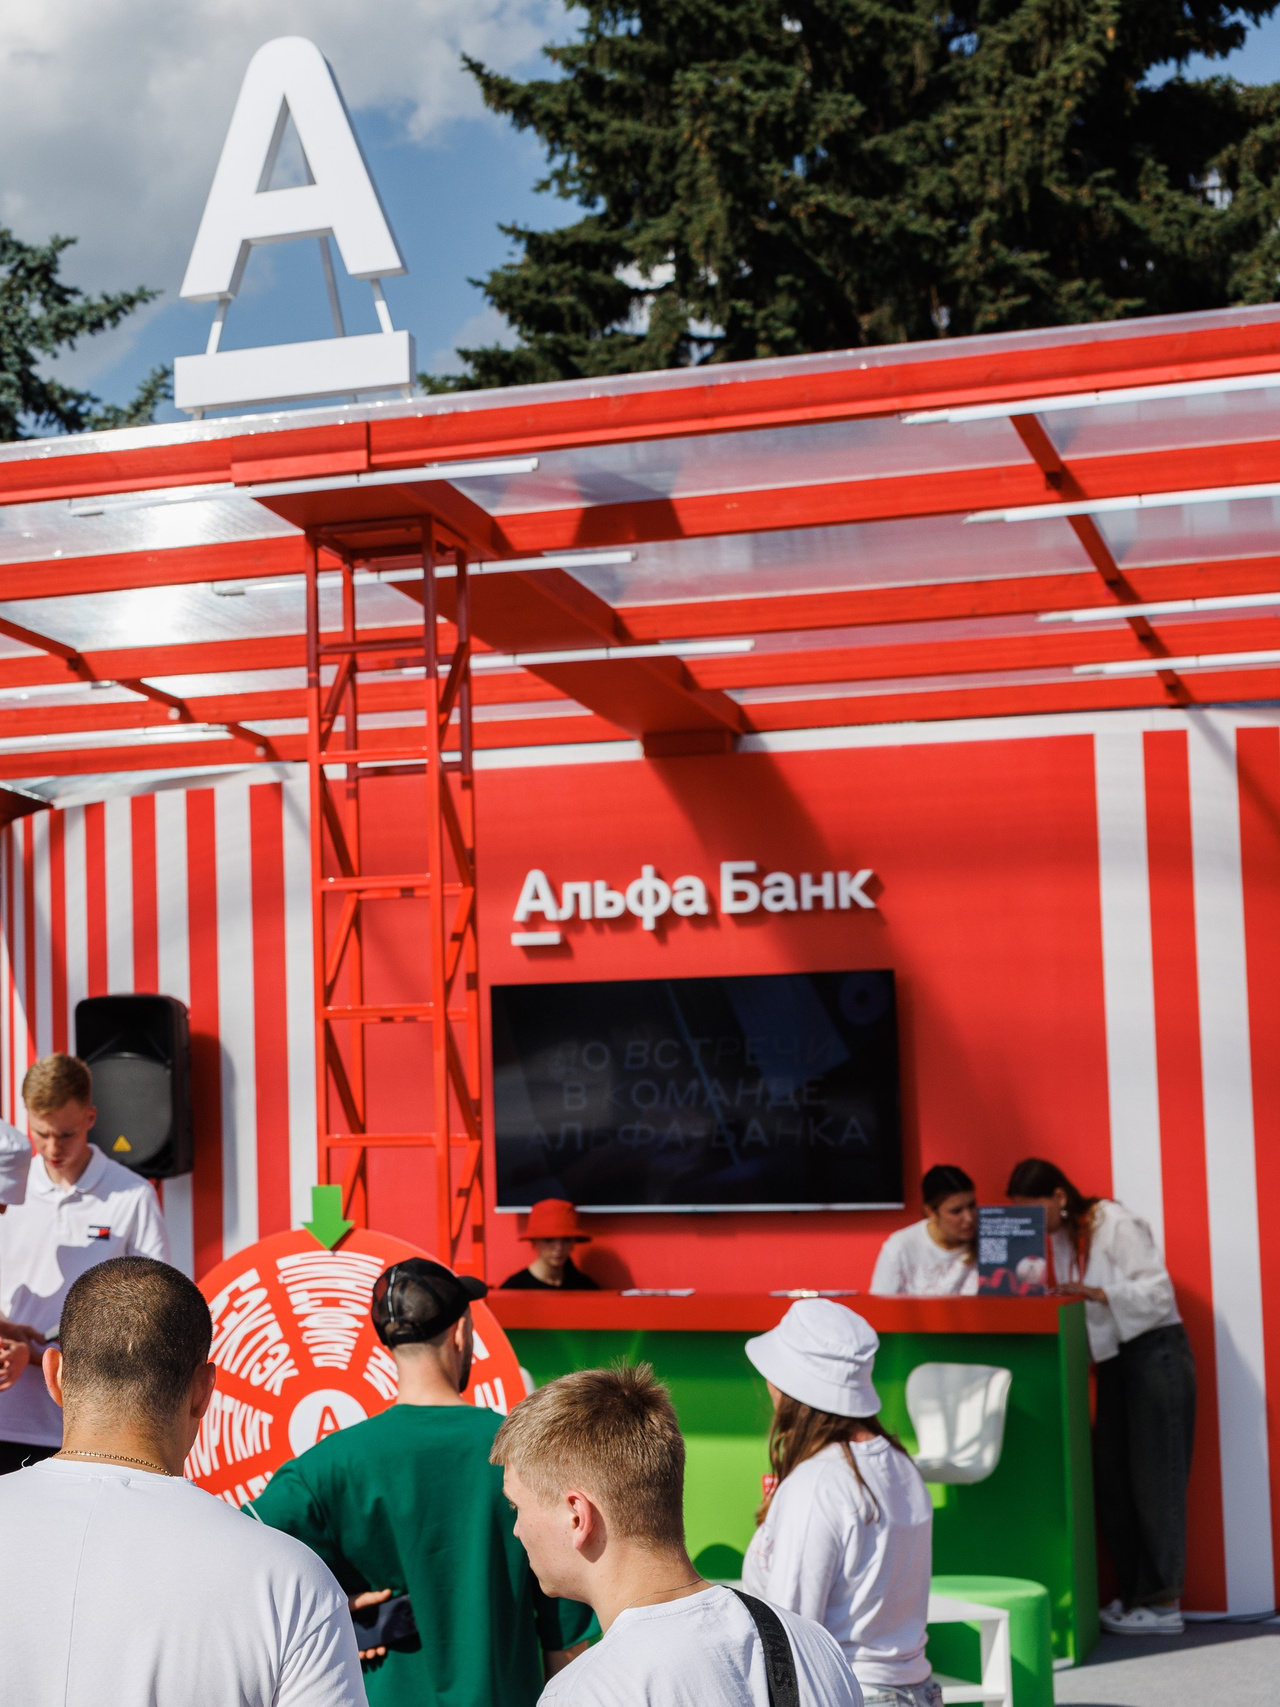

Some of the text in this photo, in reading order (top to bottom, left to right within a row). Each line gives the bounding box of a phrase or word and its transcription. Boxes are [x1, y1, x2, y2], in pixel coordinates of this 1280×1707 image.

[179, 35, 409, 300] А
[512, 861, 876, 932] Альфа Банк
[563, 1077, 828, 1111] В КОМАНДЕ
